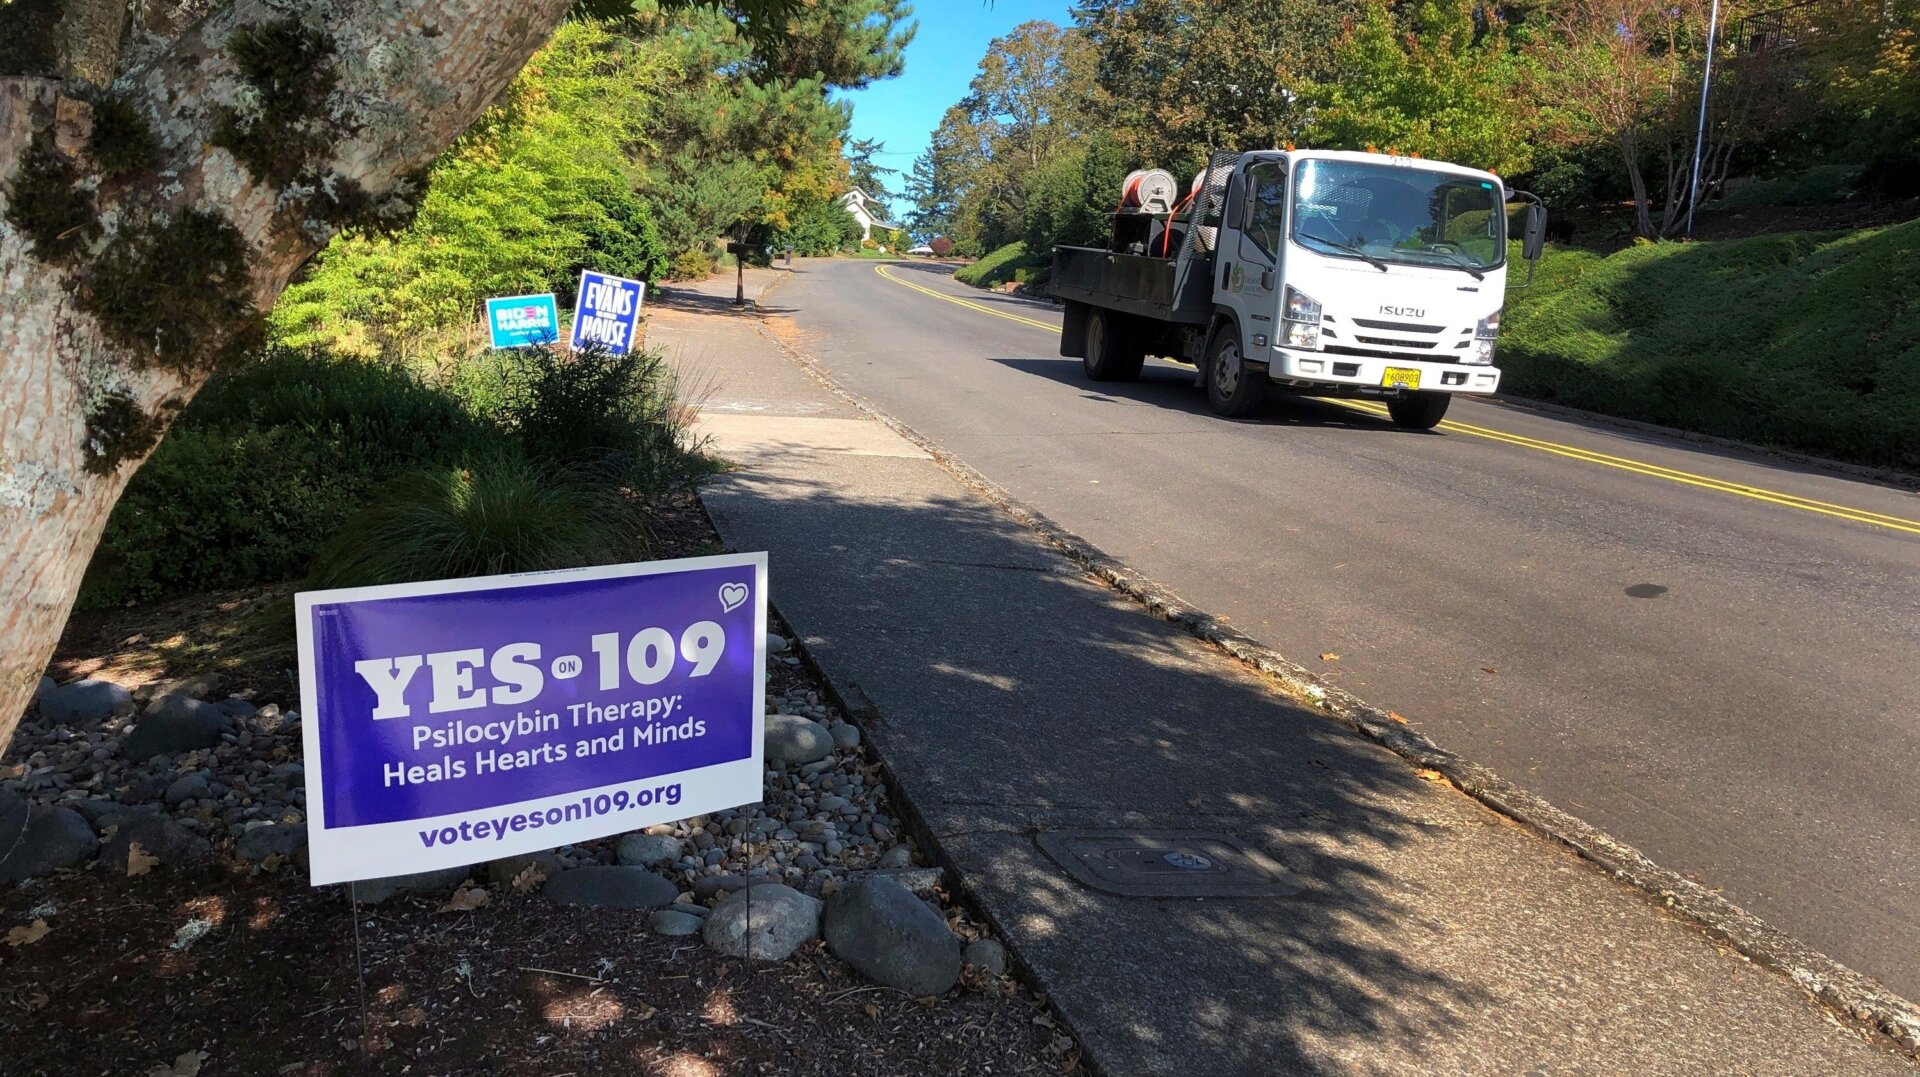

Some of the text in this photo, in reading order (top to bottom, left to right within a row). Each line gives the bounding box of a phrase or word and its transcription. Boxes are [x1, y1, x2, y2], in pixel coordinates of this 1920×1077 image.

[495, 305, 549, 321] BIDEN
[585, 281, 635, 316] EVANS
[1379, 305, 1425, 318] ISUZU
[497, 317, 551, 331] HARRIS
[579, 314, 628, 347] HOUSE
[354, 620, 726, 721] YES ON 109
[412, 694, 683, 751] Psilocybin Therapy:
[383, 716, 707, 788] Heals Hearts and Minds
[418, 783, 683, 848] voteyeson109.org
